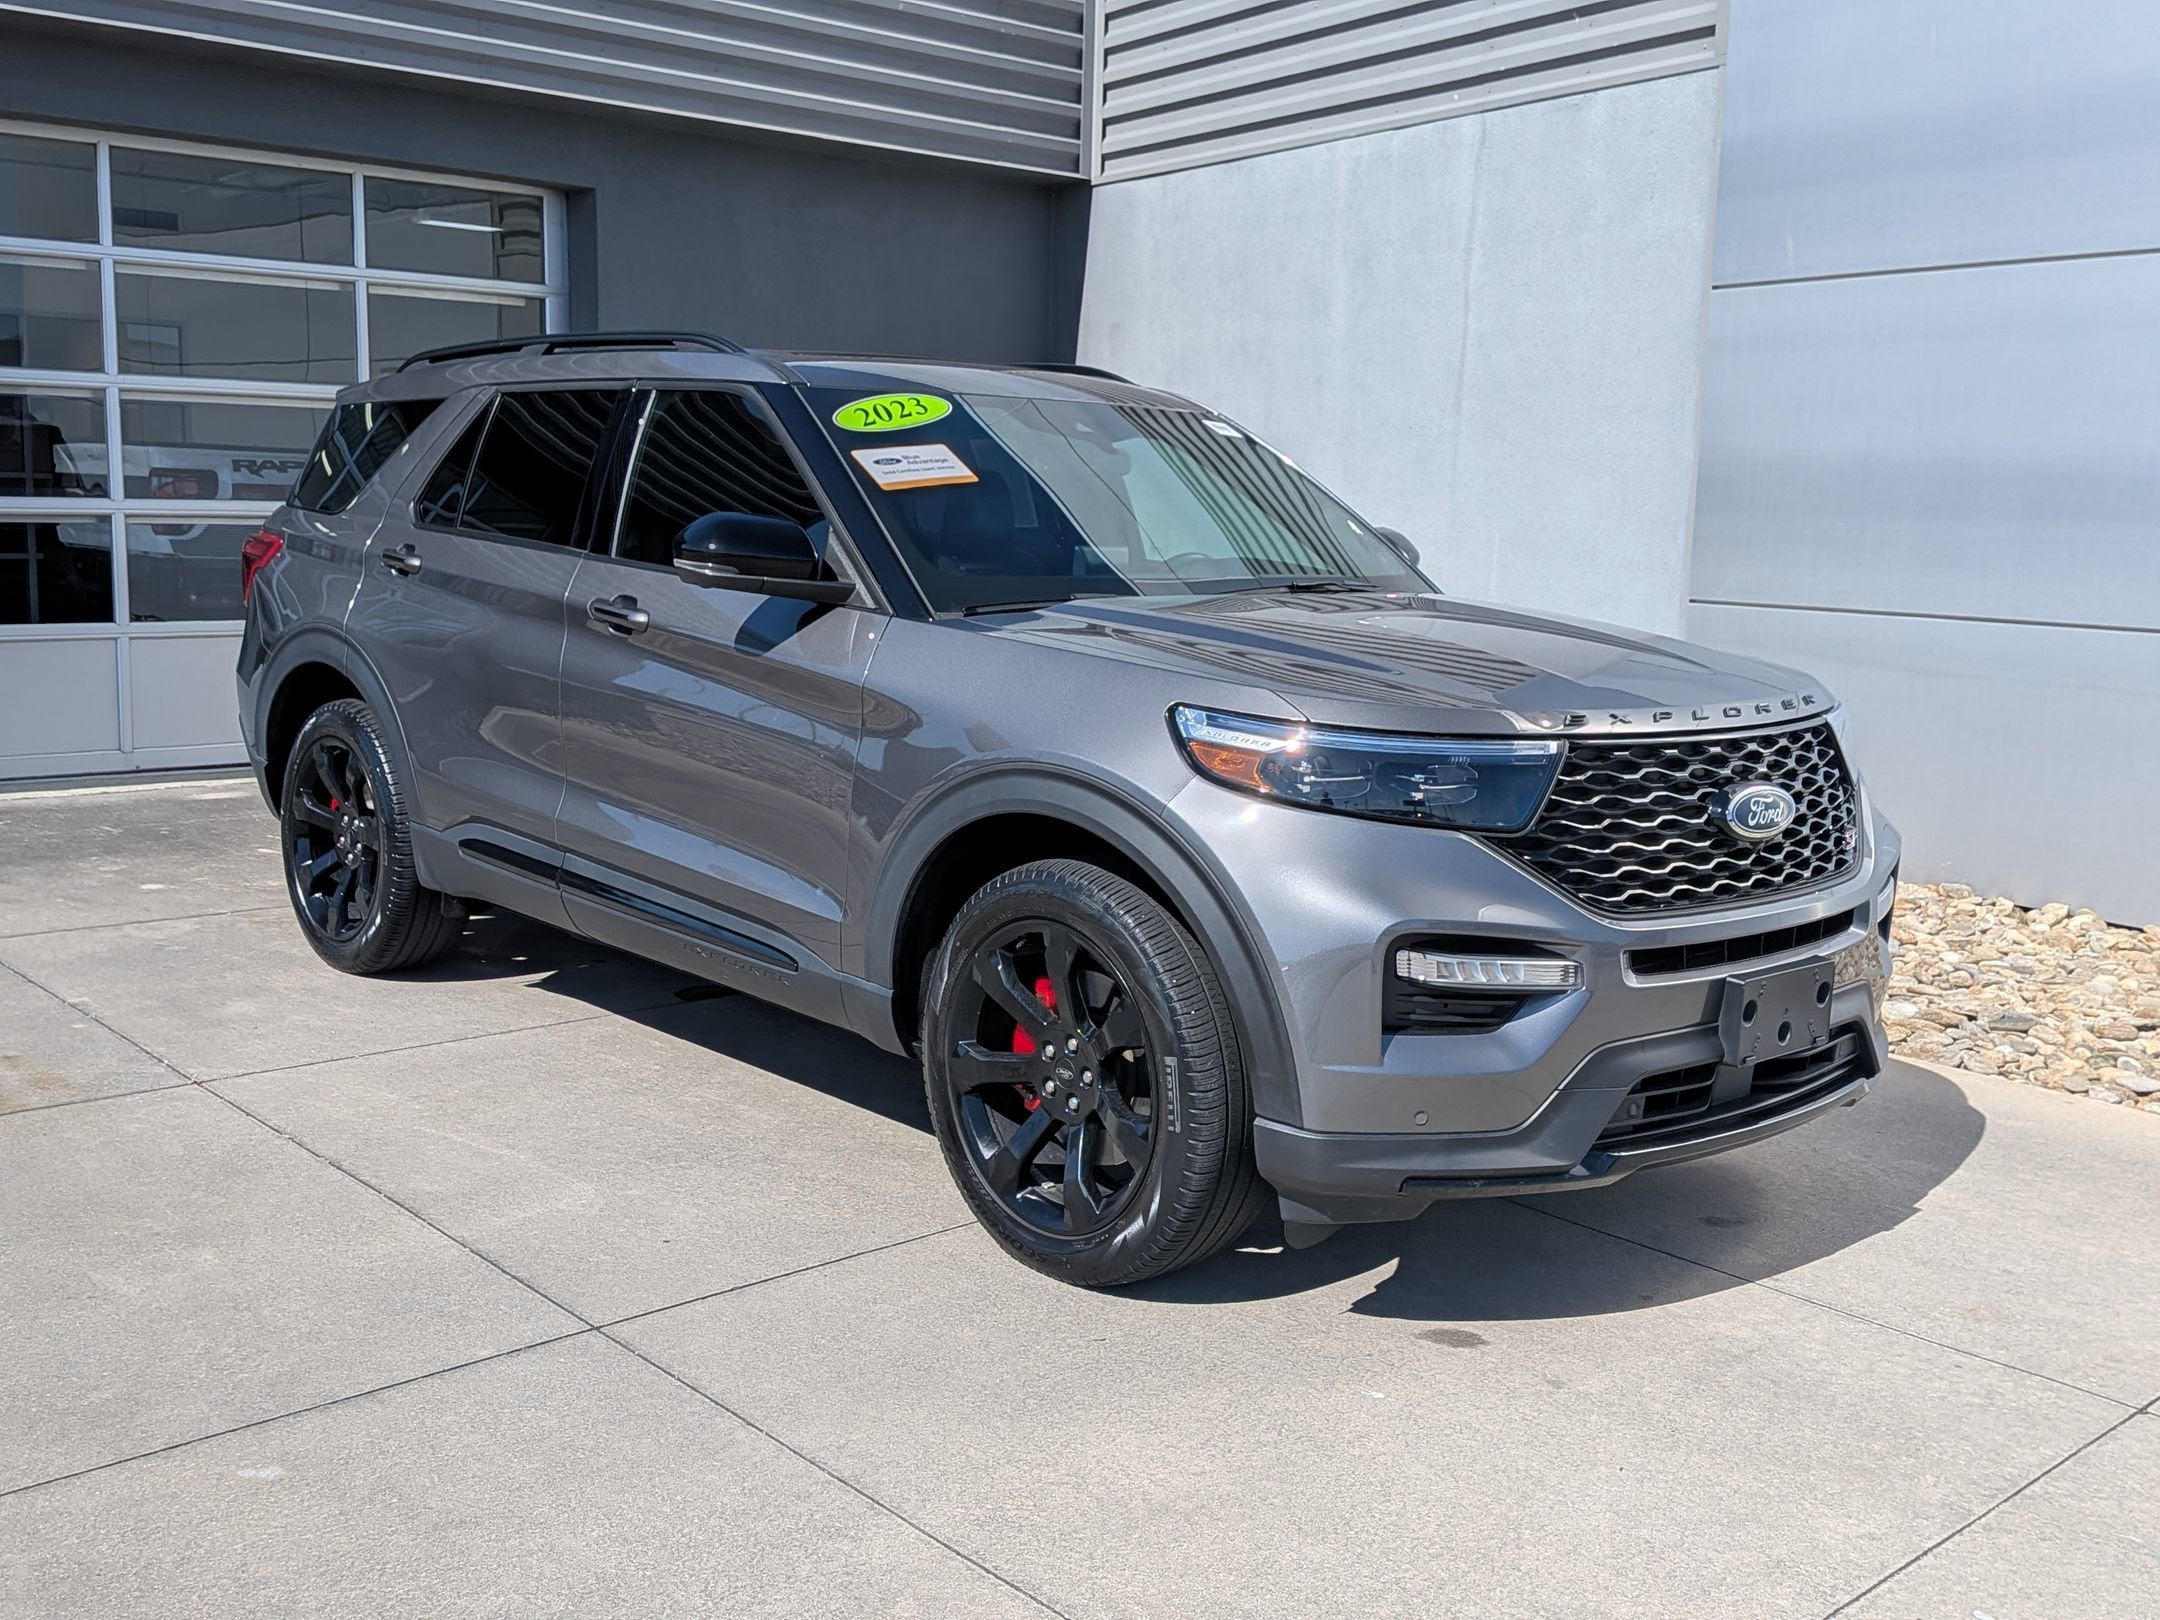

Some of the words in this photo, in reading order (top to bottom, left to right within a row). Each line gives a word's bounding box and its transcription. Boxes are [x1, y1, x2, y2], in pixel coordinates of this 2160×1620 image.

[854, 397, 928, 427] 2023
[906, 458, 949, 466] Advantage
[1563, 694, 1816, 728] EXPLORER
[1748, 797, 1784, 826] Ford
[684, 943, 790, 986] EXPLORER
[1163, 1056, 1181, 1133] PIRELLI
